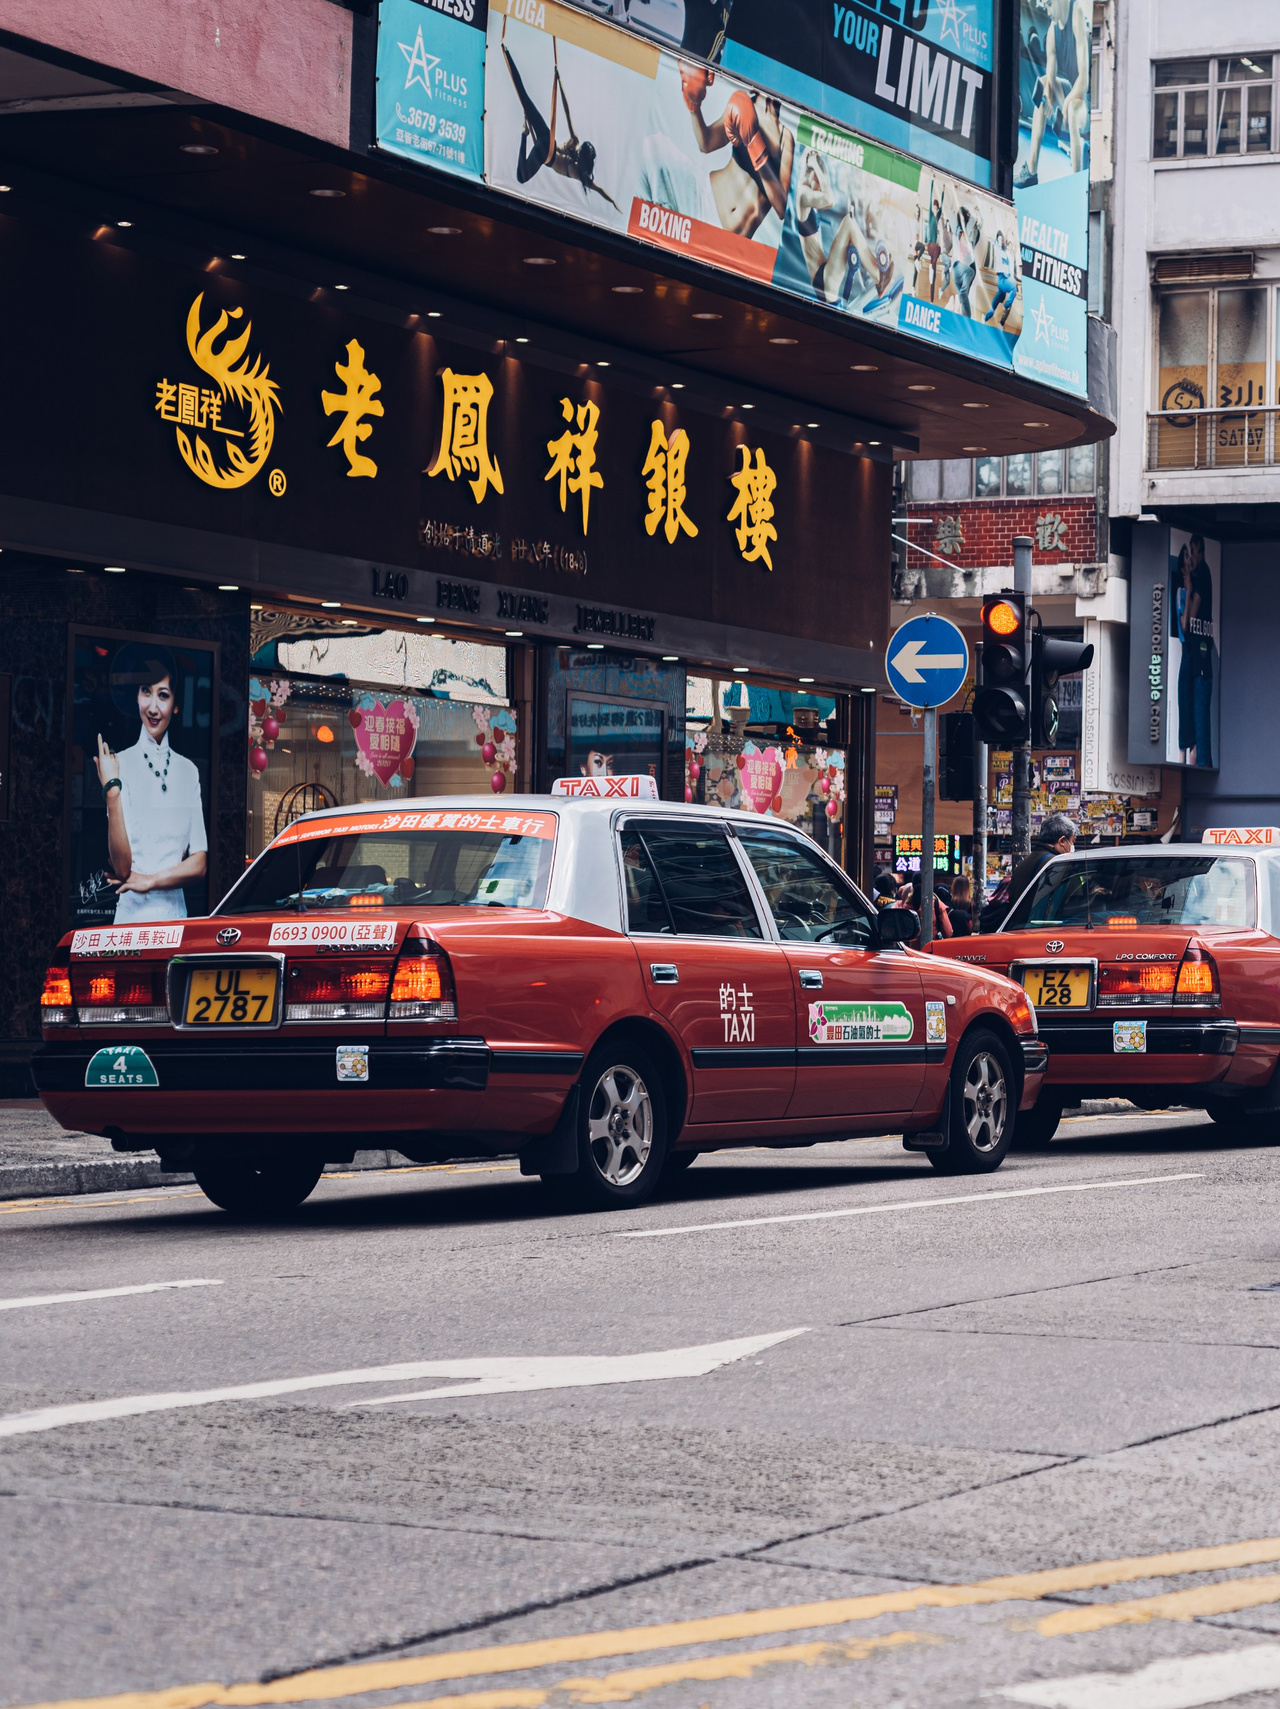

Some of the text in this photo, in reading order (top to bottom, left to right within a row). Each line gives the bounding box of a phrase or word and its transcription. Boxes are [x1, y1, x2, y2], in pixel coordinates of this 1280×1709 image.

[832, 3, 878, 57] YOUR
[963, 22, 987, 49] PLUS
[435, 67, 467, 96] PLUS
[875, 24, 984, 138] LIMIT
[434, 88, 467, 108] fitness
[407, 107, 466, 144] 3679 3539
[810, 125, 864, 168] TRAINING
[639, 202, 692, 244] BOXING
[1021, 215, 1069, 260] HEALTH
[1021, 247, 1082, 295] AND FITNESS
[905, 301, 941, 333] DANCE
[1051, 324, 1069, 343] PLUS
[155, 378, 245, 437] 老鳳祥
[1219, 428, 1263, 451] SATAY
[373, 568, 408, 599] LAO
[437, 580, 480, 613] FENG
[497, 590, 549, 624] XIANG
[1189, 617, 1202, 636] FEEL
[364, 715, 406, 735] 迎春接福
[560, 777, 640, 798] TAXI
[332, 826, 349, 834] TAXI
[349, 823, 379, 832] MOTORS
[379, 813, 545, 834] 沙田優質的士車行
[1209, 829, 1272, 845] TAXI
[74, 929, 180, 950] 沙田 大埔 馬鞍山
[273, 926, 308, 941] 6693
[311, 925, 348, 940] 0900
[215, 971, 251, 996] UL
[1042, 969, 1070, 988] EZ
[719, 983, 753, 1011] 的士
[1037, 988, 1072, 1006] 128
[193, 997, 270, 1023] 2787
[721, 1013, 755, 1042] TAXI
[113, 1056, 127, 1073] 4
[100, 1074, 143, 1083] SEATS
